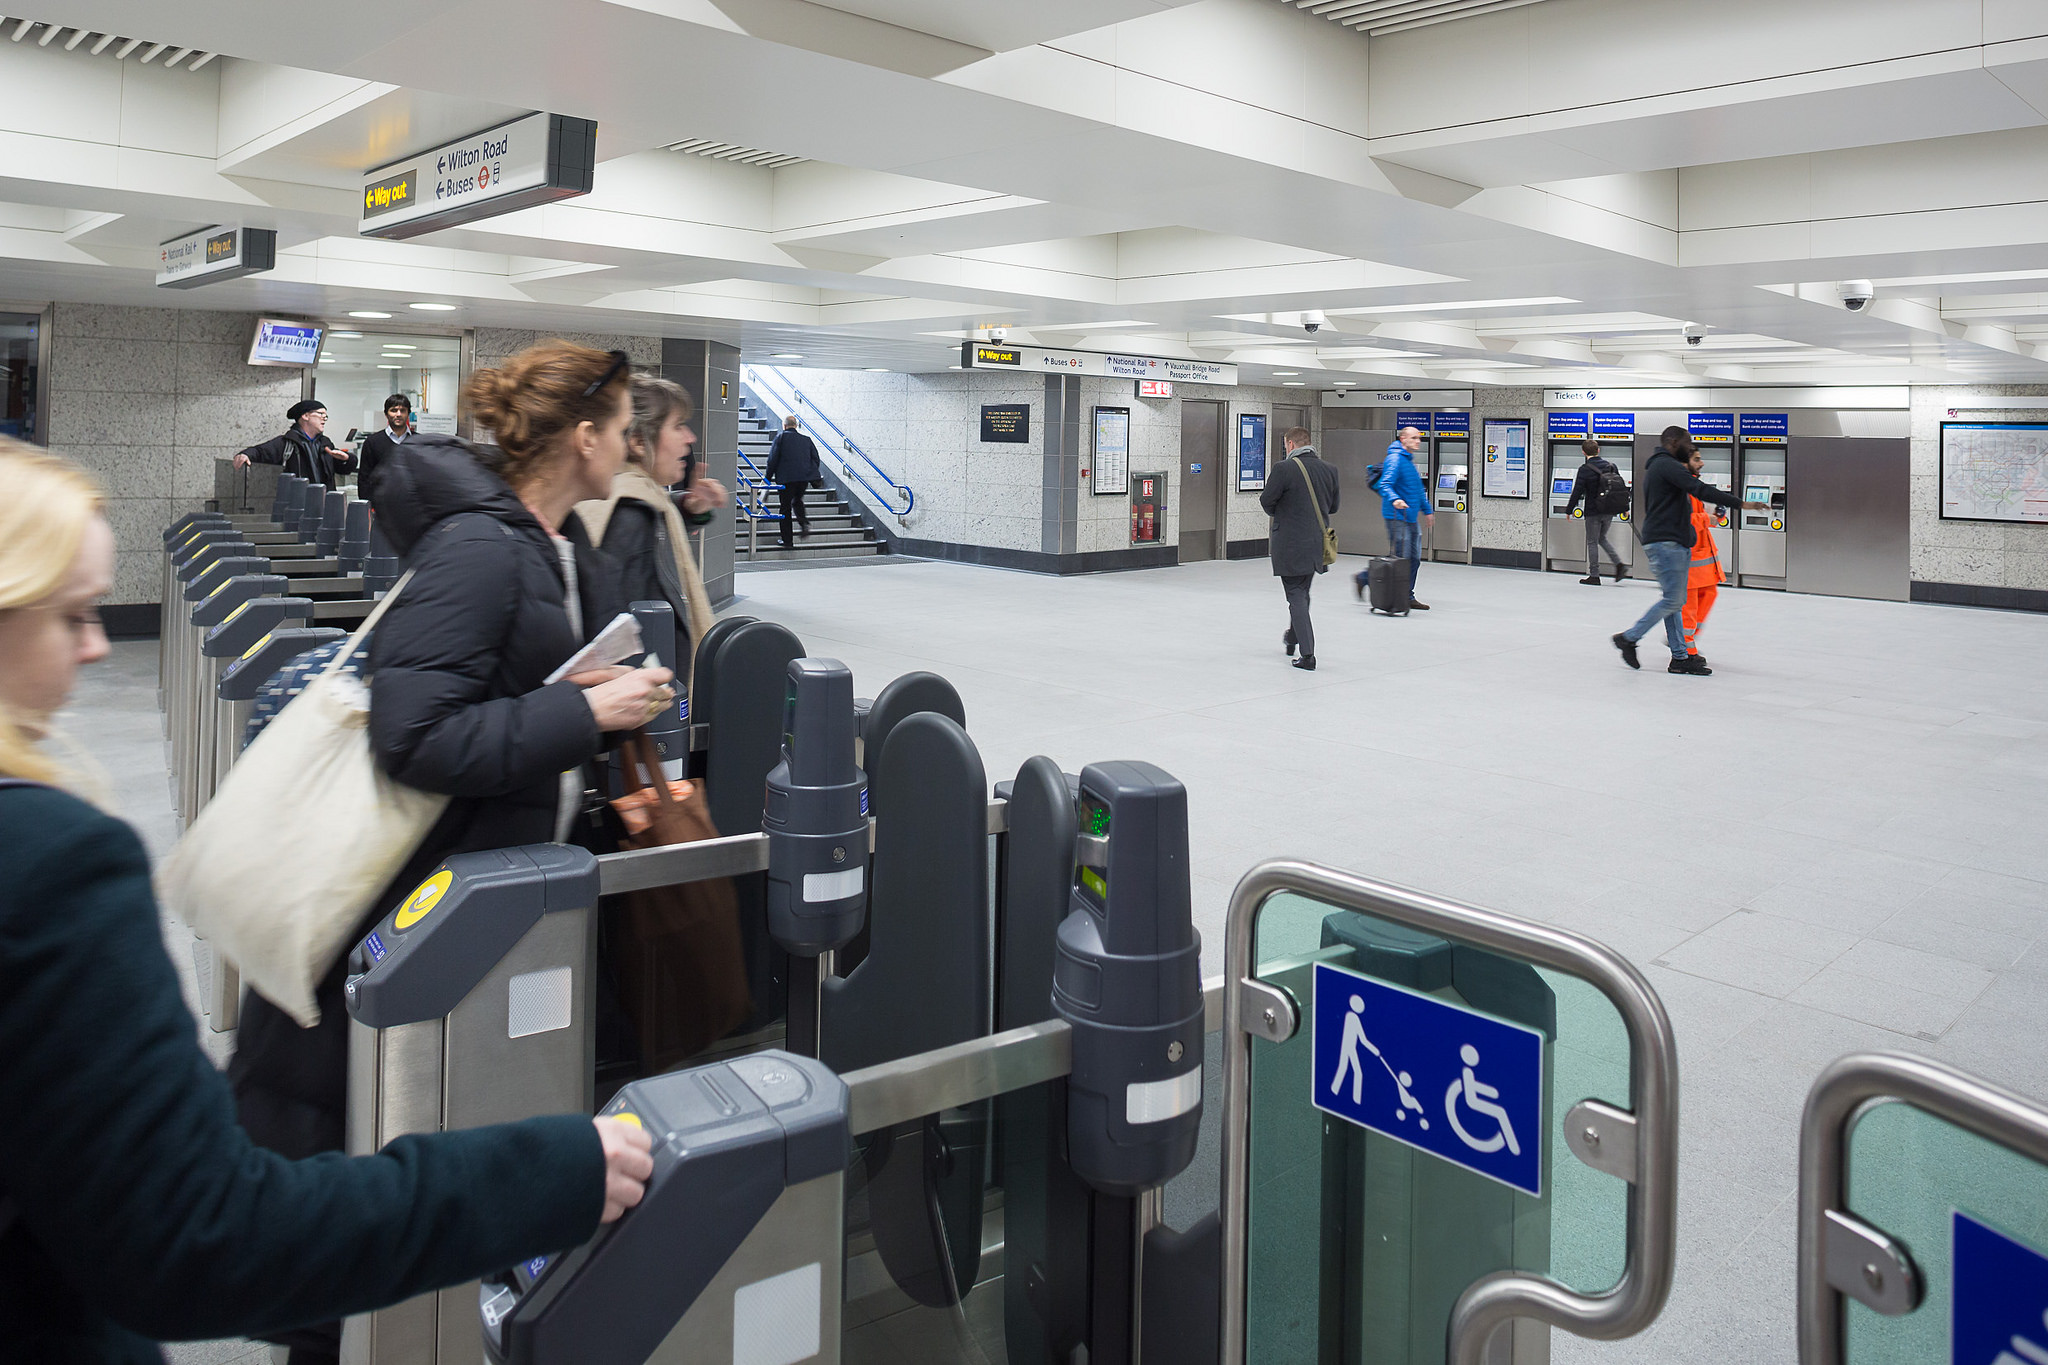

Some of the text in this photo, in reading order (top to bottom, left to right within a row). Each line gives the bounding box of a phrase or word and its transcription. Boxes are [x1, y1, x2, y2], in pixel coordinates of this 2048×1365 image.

[448, 134, 508, 172] Wilton Road
[447, 176, 474, 198] Buses
[375, 181, 406, 208] Way out
[168, 244, 184, 260] National
[212, 238, 231, 256] Way out
[986, 351, 1012, 361] Way out
[1051, 358, 1067, 366] Buses
[1113, 358, 1136, 366] National
[1113, 366, 1131, 375] Wilton
[1170, 363, 1190, 371] Vauxhall
[1192, 364, 1207, 373] Bridge
[1170, 371, 1190, 380] Passport
